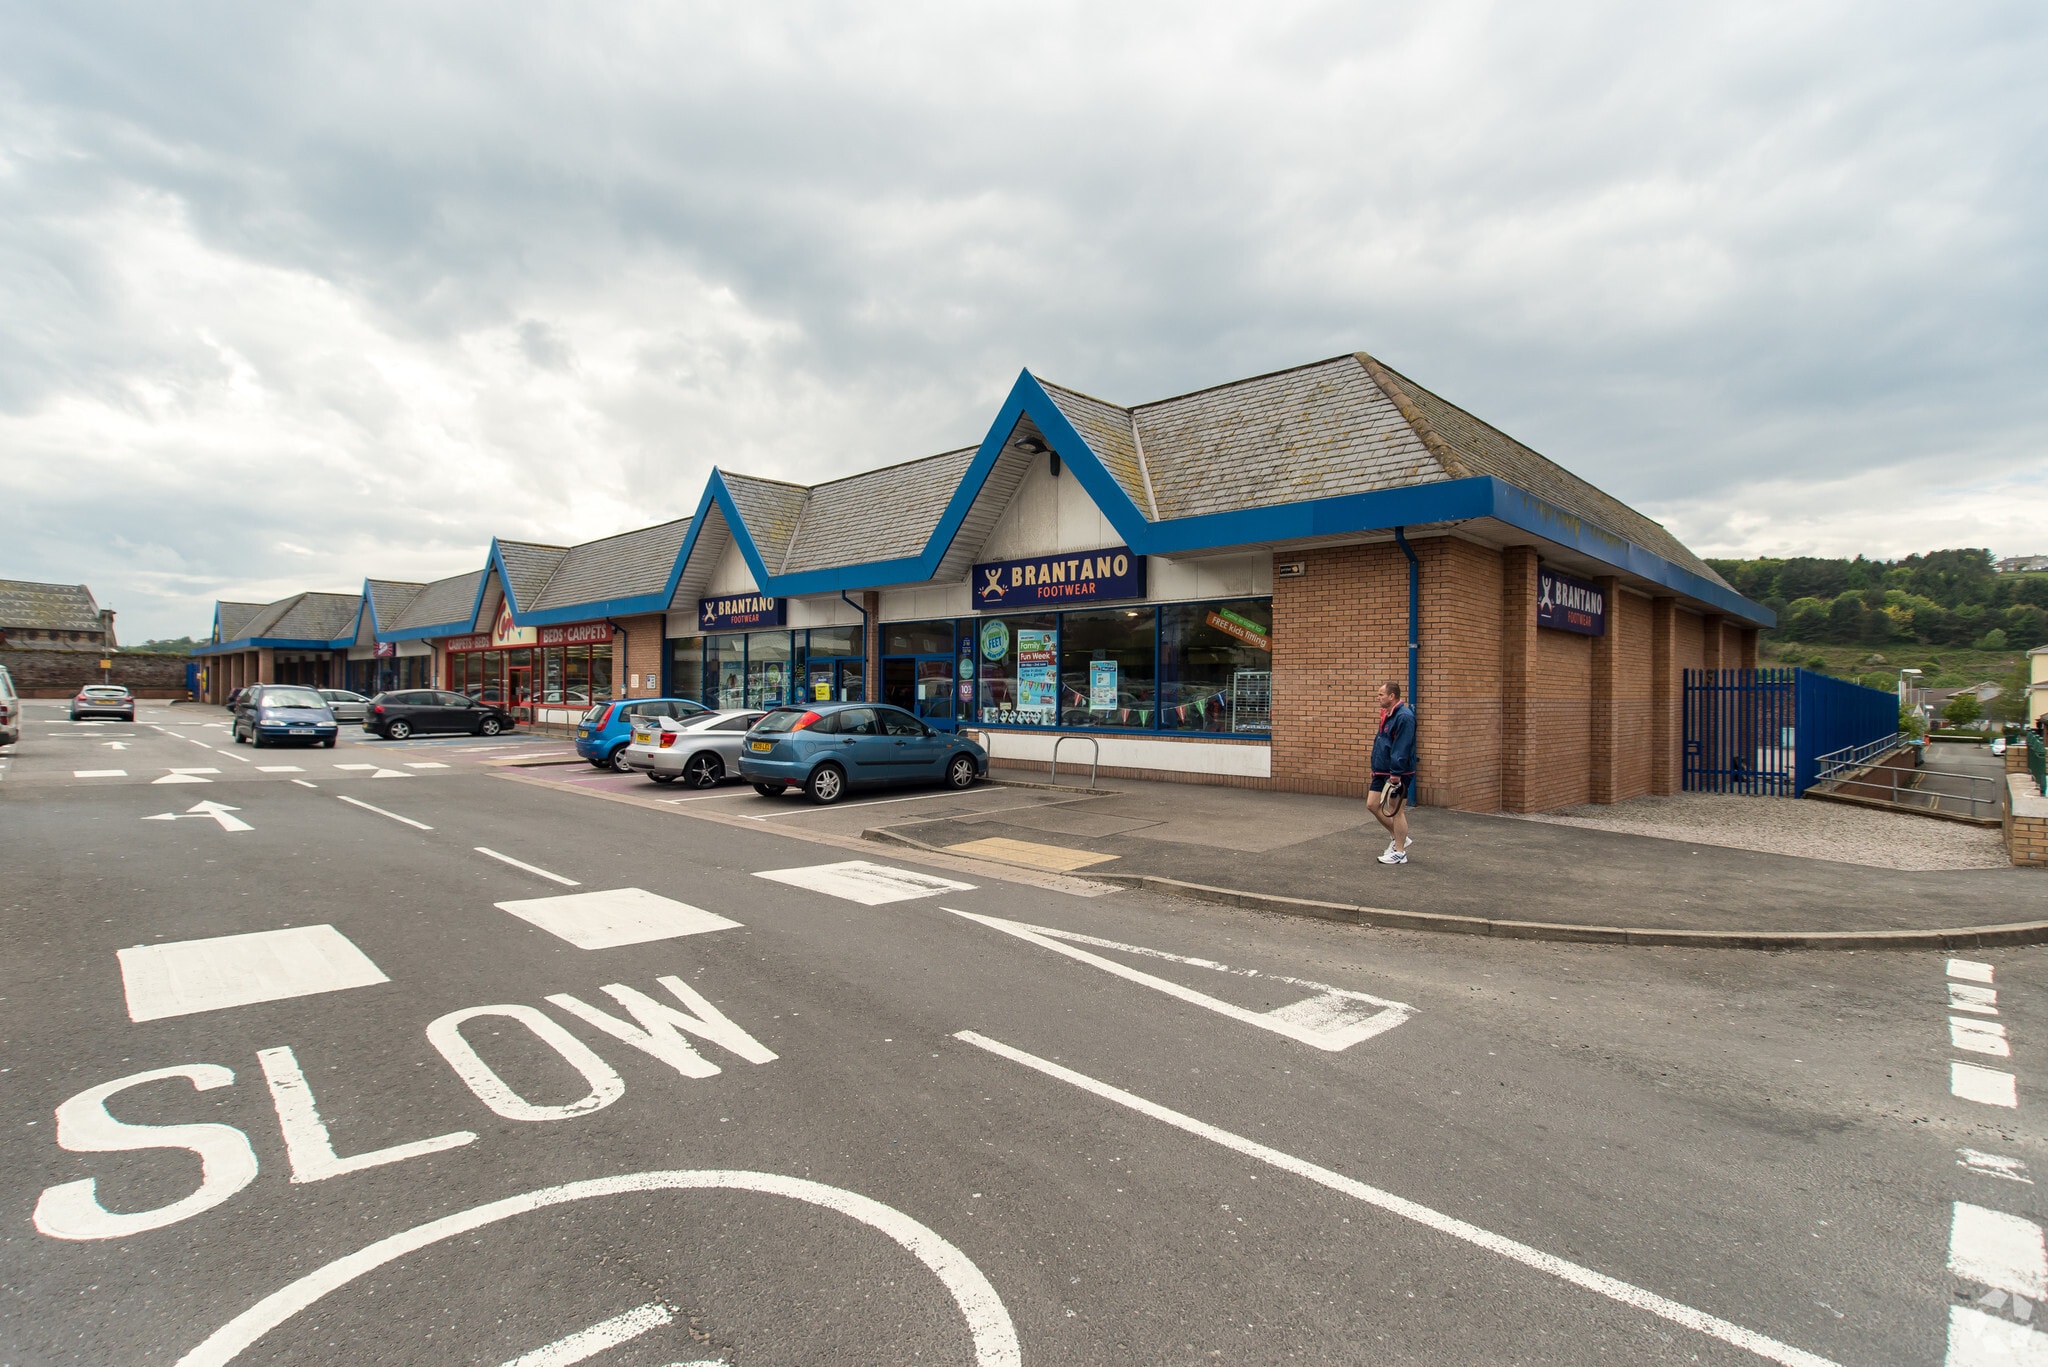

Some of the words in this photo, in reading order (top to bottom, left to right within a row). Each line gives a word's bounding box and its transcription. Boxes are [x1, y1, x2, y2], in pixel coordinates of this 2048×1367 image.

[1012, 554, 1128, 587] BRANTANO
[1037, 582, 1096, 599] FOOTWEAR
[1556, 581, 1602, 615] BRANTANO
[718, 597, 775, 616] BRANTANO
[731, 613, 760, 624] FOOTWEAR
[1568, 611, 1591, 627] FOOTWEAR
[543, 628, 563, 643] BEDS
[567, 623, 607, 641] CARPETS
[1211, 616, 1229, 630] FREE
[1228, 623, 1244, 637] kids
[1244, 630, 1267, 648] fitting
[448, 637, 473, 650] CARPETS
[474, 635, 490, 648] BEDS
[988, 636, 1002, 649] FEET
[1020, 641, 1041, 650] Family
[1032, 651, 1051, 659] Week
[33, 974, 779, 1241] SLOW
